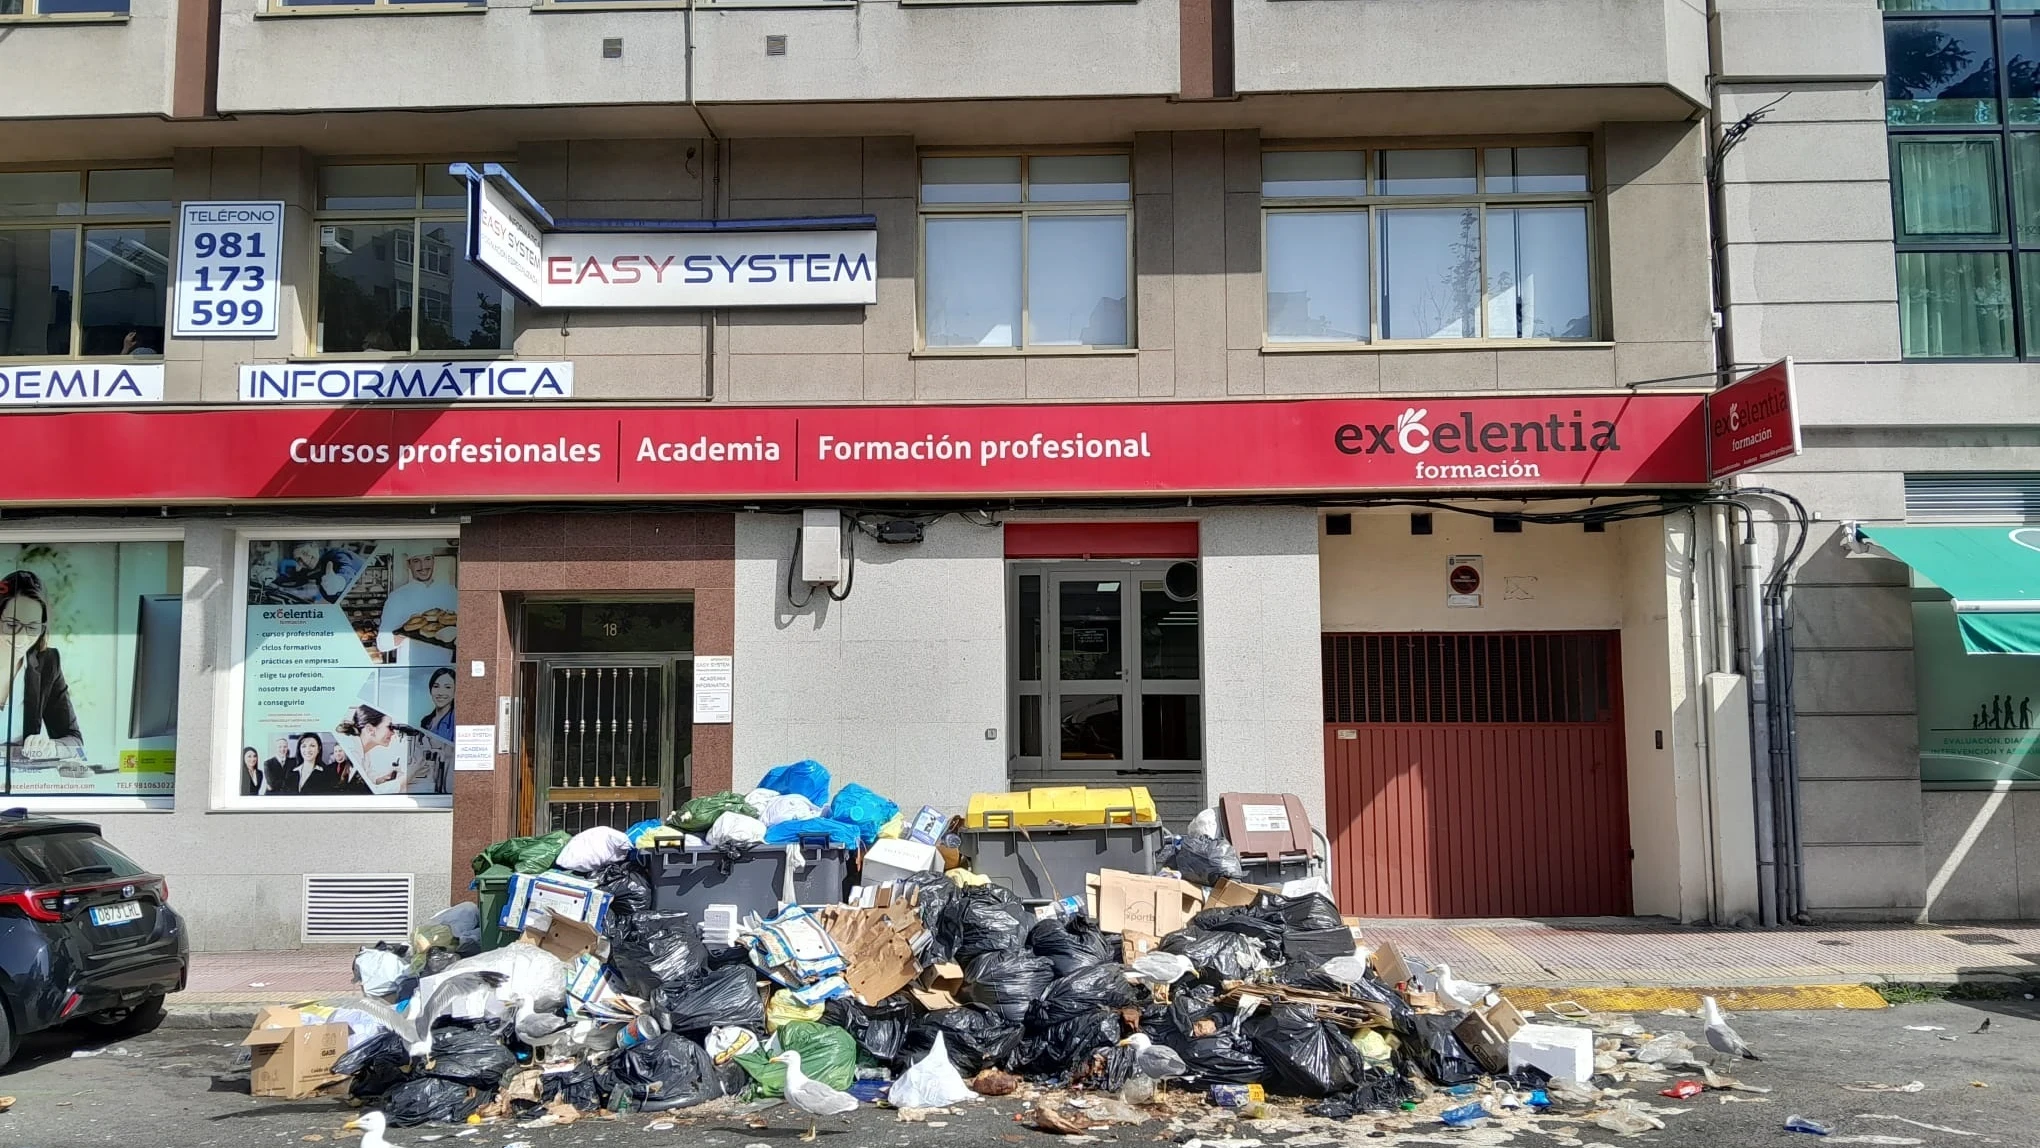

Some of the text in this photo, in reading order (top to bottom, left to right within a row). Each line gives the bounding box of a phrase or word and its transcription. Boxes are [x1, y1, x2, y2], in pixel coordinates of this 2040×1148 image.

[188, 208, 275, 222] TELÉFONO
[194, 232, 265, 258] 981
[482, 208, 541, 270] EASY SYSTEM
[194, 266, 264, 291] 173
[547, 253, 872, 284] EASY SYSTEM
[191, 299, 263, 325] 599
[250, 362, 563, 398] INFORMÁTICA
[1714, 387, 1789, 438] excelentia
[1334, 408, 1620, 454] excelentia
[1731, 427, 1773, 452] formación
[289, 437, 601, 470] Cursos profesionales
[636, 435, 780, 462] Academia
[819, 432, 1151, 467] Formación profesional
[1415, 460, 1540, 479] formación
[262, 608, 324, 619] excelentia
[286, 630, 335, 639] profesionales
[602, 623, 617, 637] 18
[261, 657, 293, 665] prácticas
[259, 672, 278, 680] elige
[299, 685, 336, 693] ayudamos
[98, 903, 141, 921] 0873 LRL
